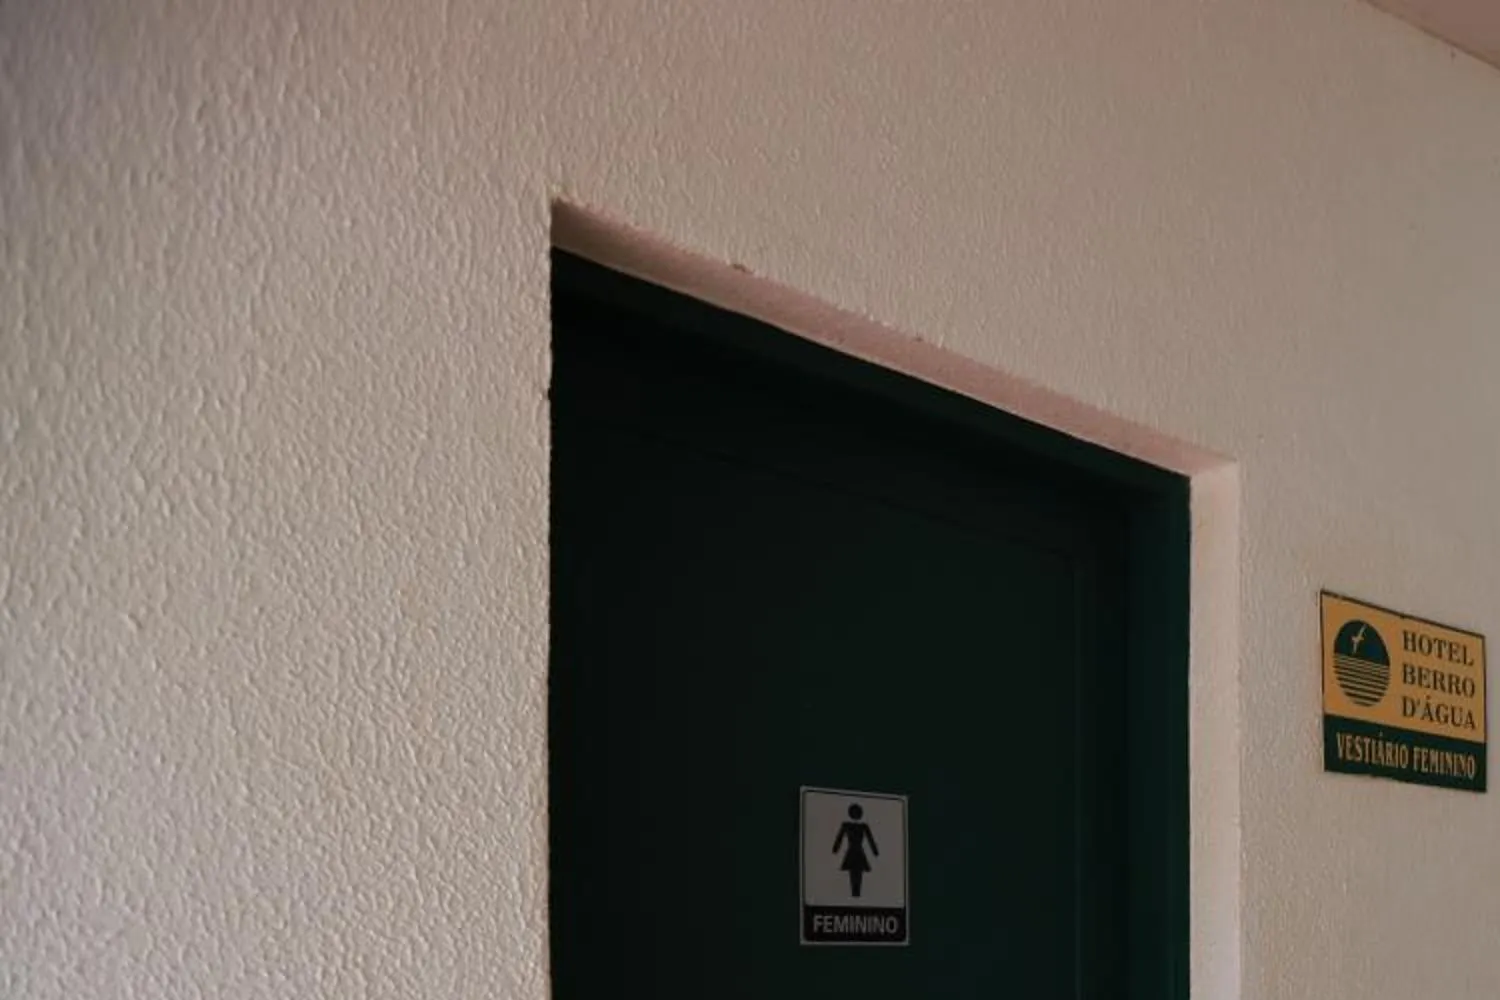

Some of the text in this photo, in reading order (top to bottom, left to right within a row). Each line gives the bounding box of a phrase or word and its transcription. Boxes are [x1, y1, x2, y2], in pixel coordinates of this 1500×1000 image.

[1402, 630, 1474, 666] HOTEL
[1402, 663, 1475, 698] BERRO
[1402, 695, 1476, 731] D'ÁGUA
[1336, 731, 1476, 780] VESTIÁRIO FEMININO
[813, 914, 899, 934] FEMININO
